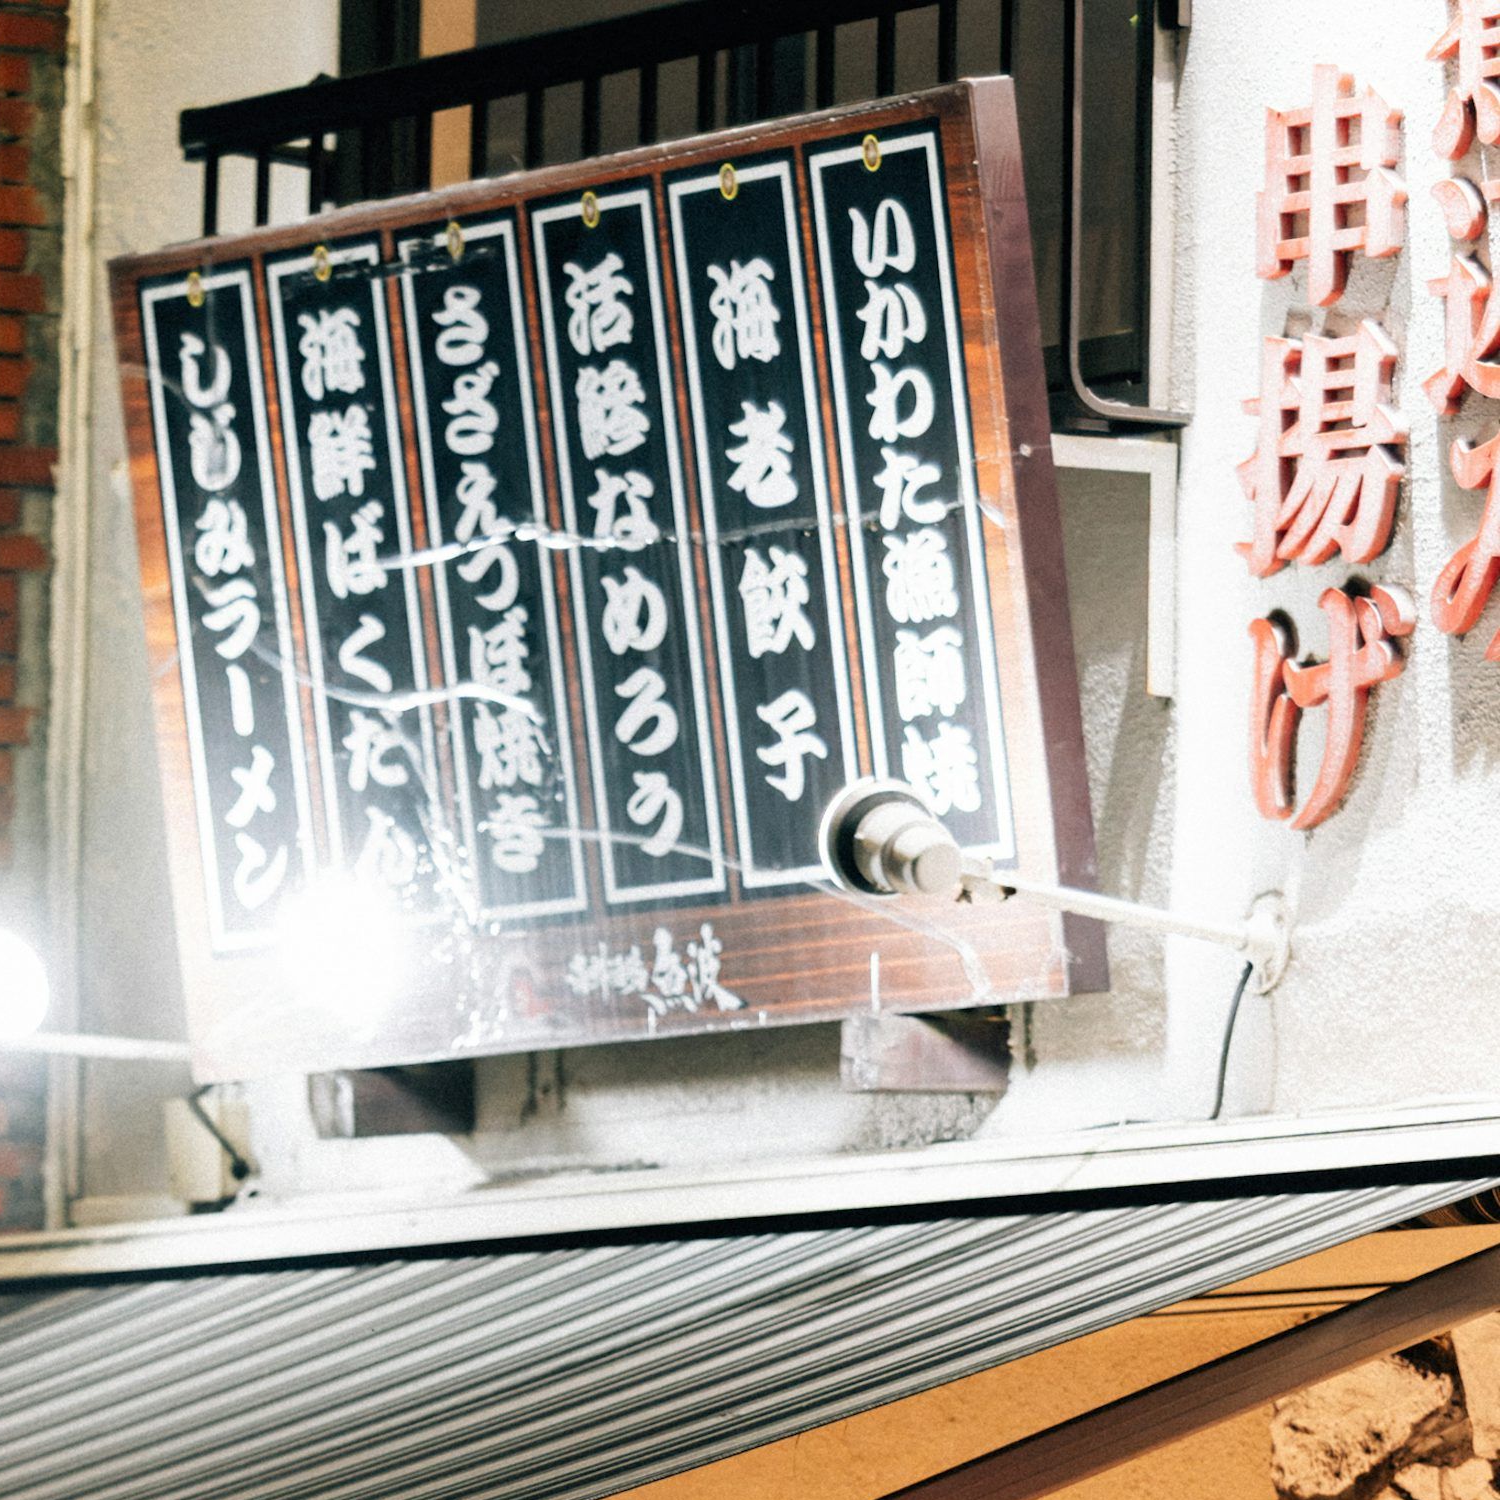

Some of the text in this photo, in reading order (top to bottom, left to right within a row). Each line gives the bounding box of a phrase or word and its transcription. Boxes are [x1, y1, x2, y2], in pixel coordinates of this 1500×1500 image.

[180, 332, 288, 911] しじみラーメン
[706, 257, 828, 802] 海老餃子
[1234, 63, 1415, 831] 串揚げ
